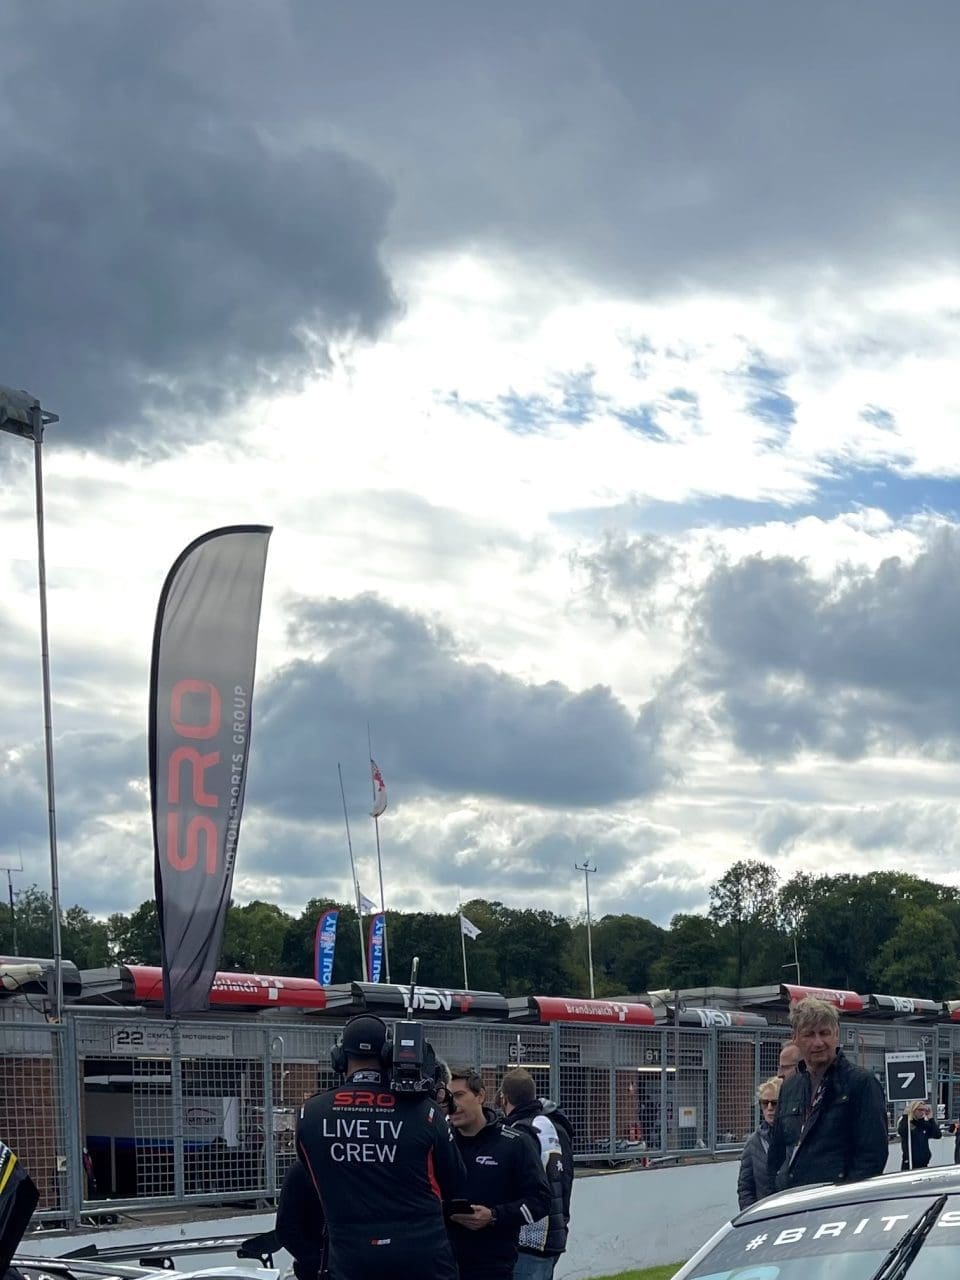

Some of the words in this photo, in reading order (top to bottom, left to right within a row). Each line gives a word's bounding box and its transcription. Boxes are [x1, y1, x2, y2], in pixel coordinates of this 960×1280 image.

[232, 684, 248, 744] GROUP
[166, 678, 222, 875] SRO
[322, 957, 335, 988] IQUI
[371, 960, 382, 984] QUI
[397, 986, 453, 1011] MSV
[892, 997, 915, 1013] MSV
[696, 1009, 732, 1027] MSV
[116, 1030, 144, 1045] 22
[646, 1050, 659, 1061] 61
[897, 1072, 916, 1089] 7
[333, 1091, 396, 1107] SRO
[322, 1118, 370, 1138] LIVE
[375, 1119, 404, 1140] TV
[330, 1142, 398, 1163] CREW
